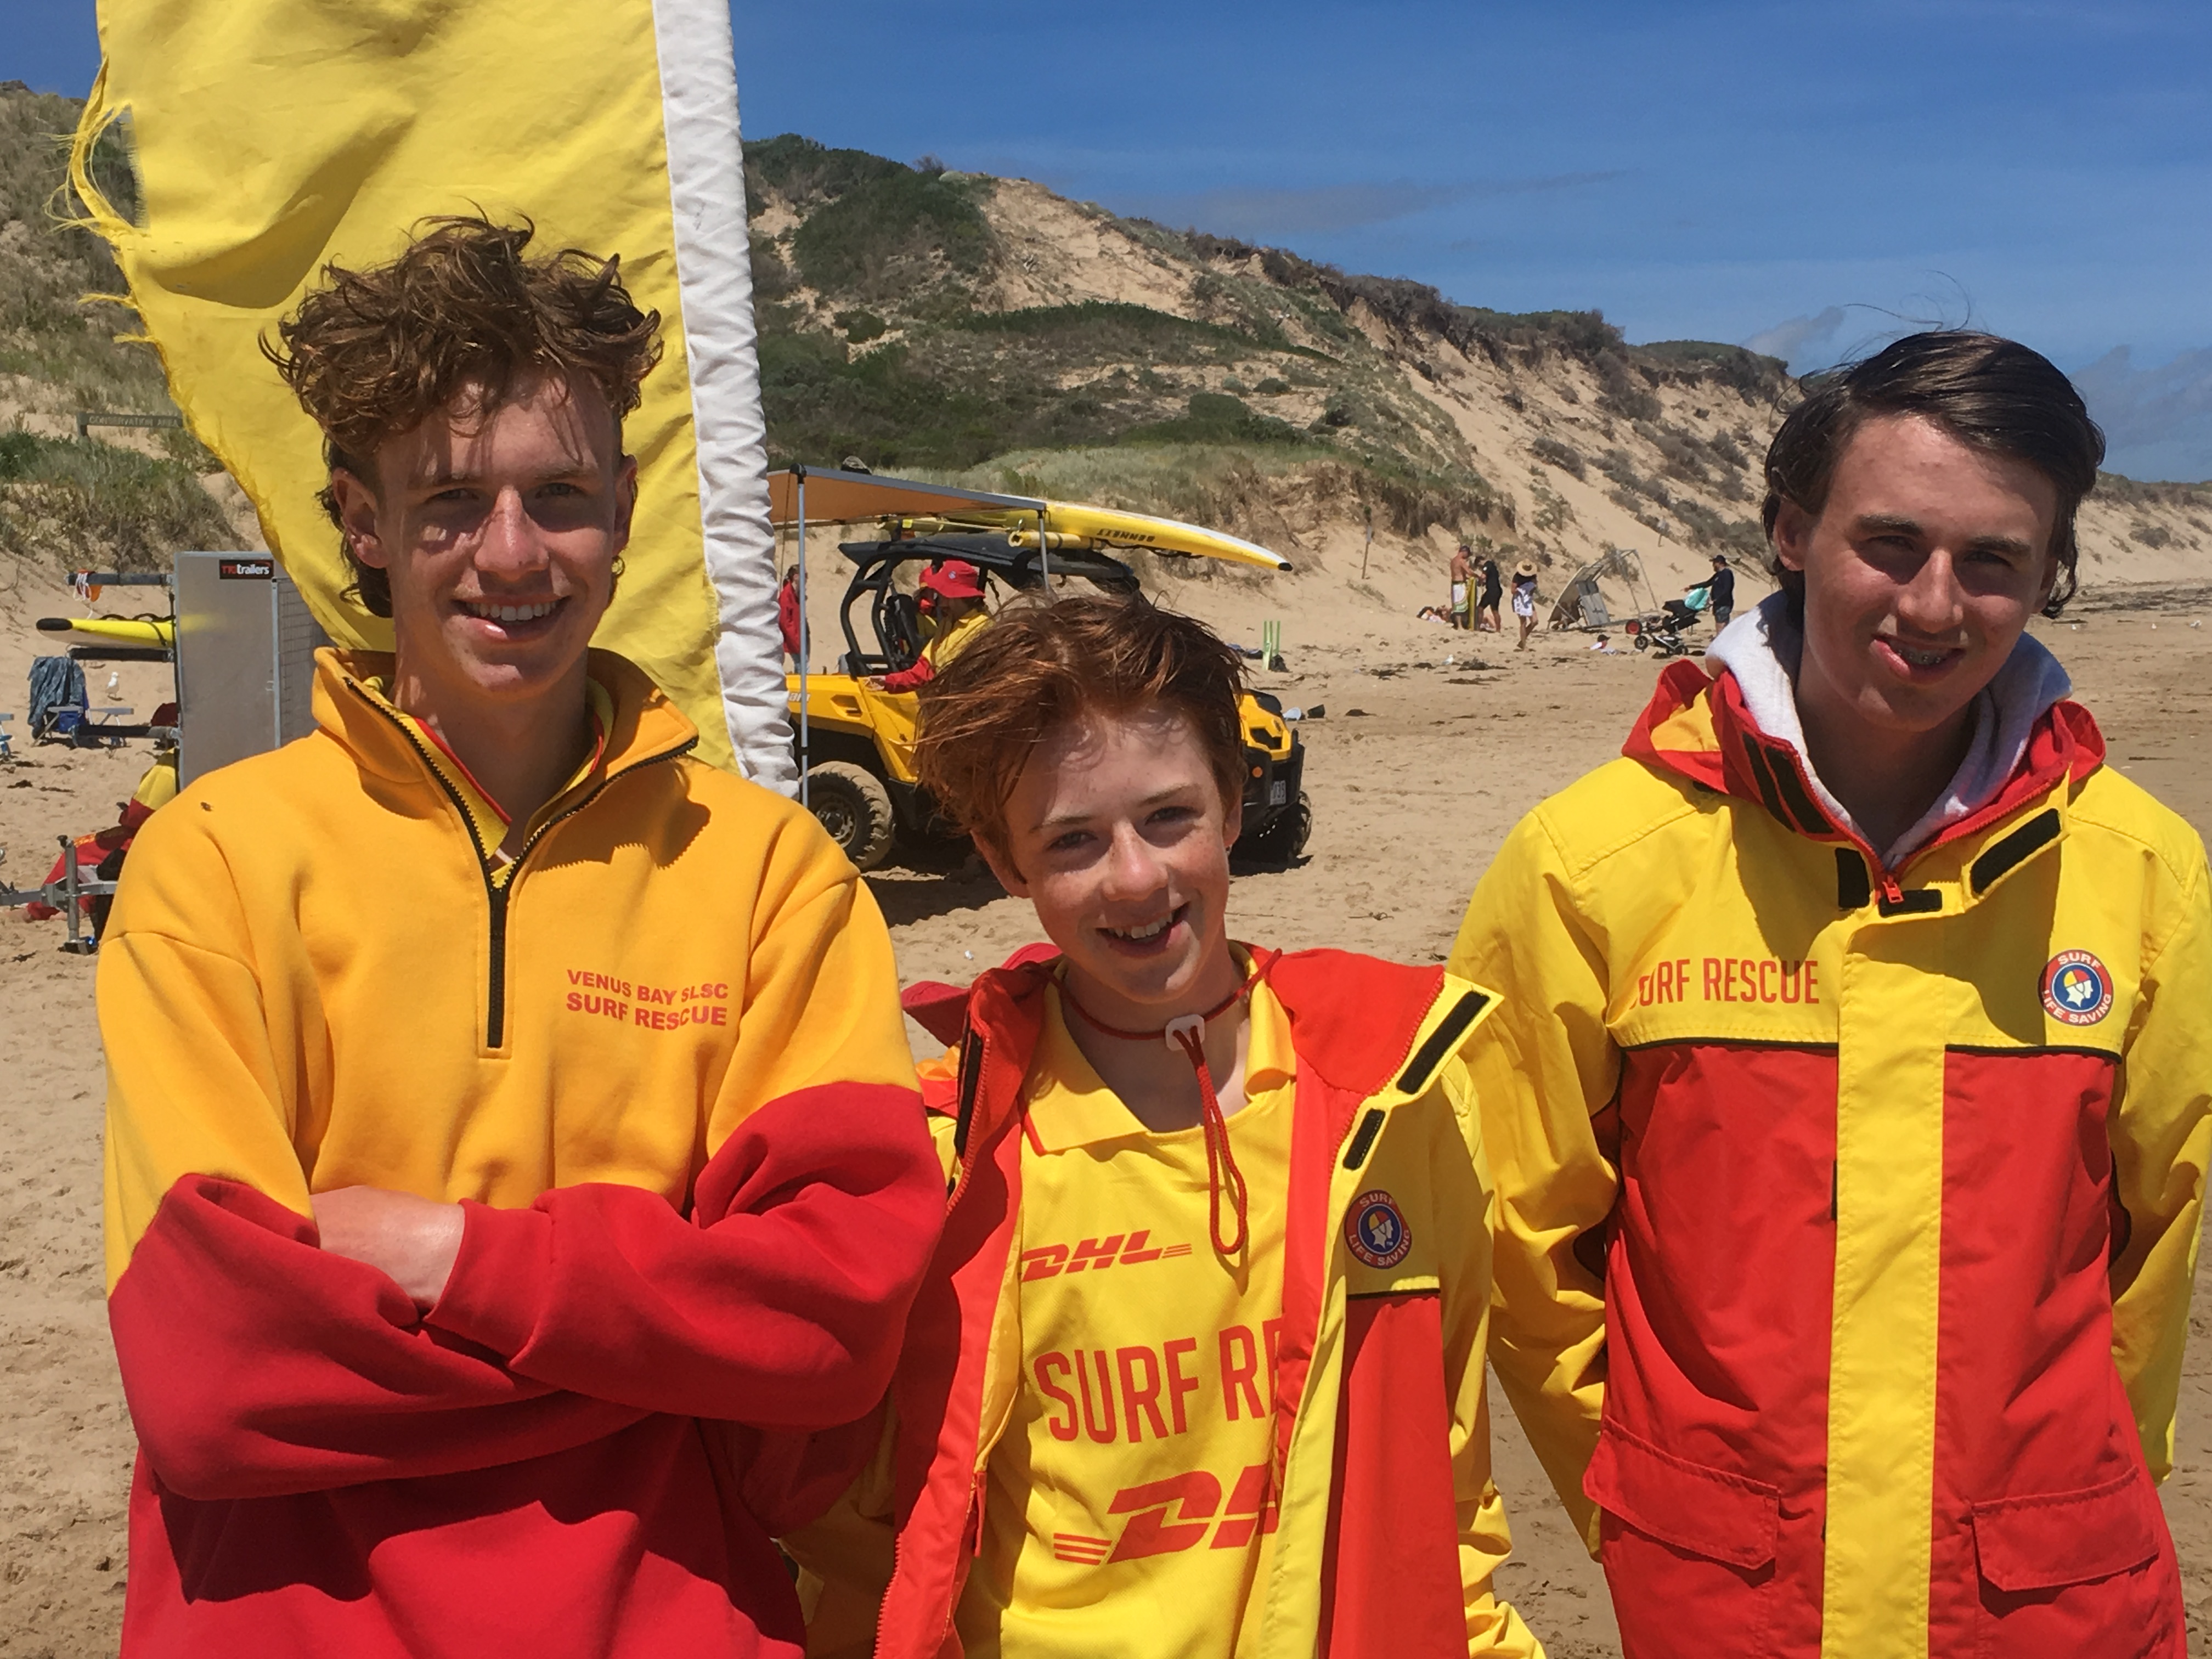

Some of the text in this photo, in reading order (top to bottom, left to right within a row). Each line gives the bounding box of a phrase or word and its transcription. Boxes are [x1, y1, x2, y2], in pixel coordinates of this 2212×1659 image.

[157, 419, 179, 427] AREA
[1097, 528, 1155, 542] BENNETT
[2058, 952, 2101, 968] SURF
[567, 969, 729, 1005] VENUS BAY SLSC
[1703, 958, 1820, 1004] RESCUE
[566, 992, 727, 1031] SURF RESCUE
[2042, 989, 2111, 1024] LIFE SAVING
[1022, 1229, 1163, 1283] DHL
[1348, 1229, 1410, 1266] LIFE SAVING
[1034, 1337, 1199, 1443] SURF
